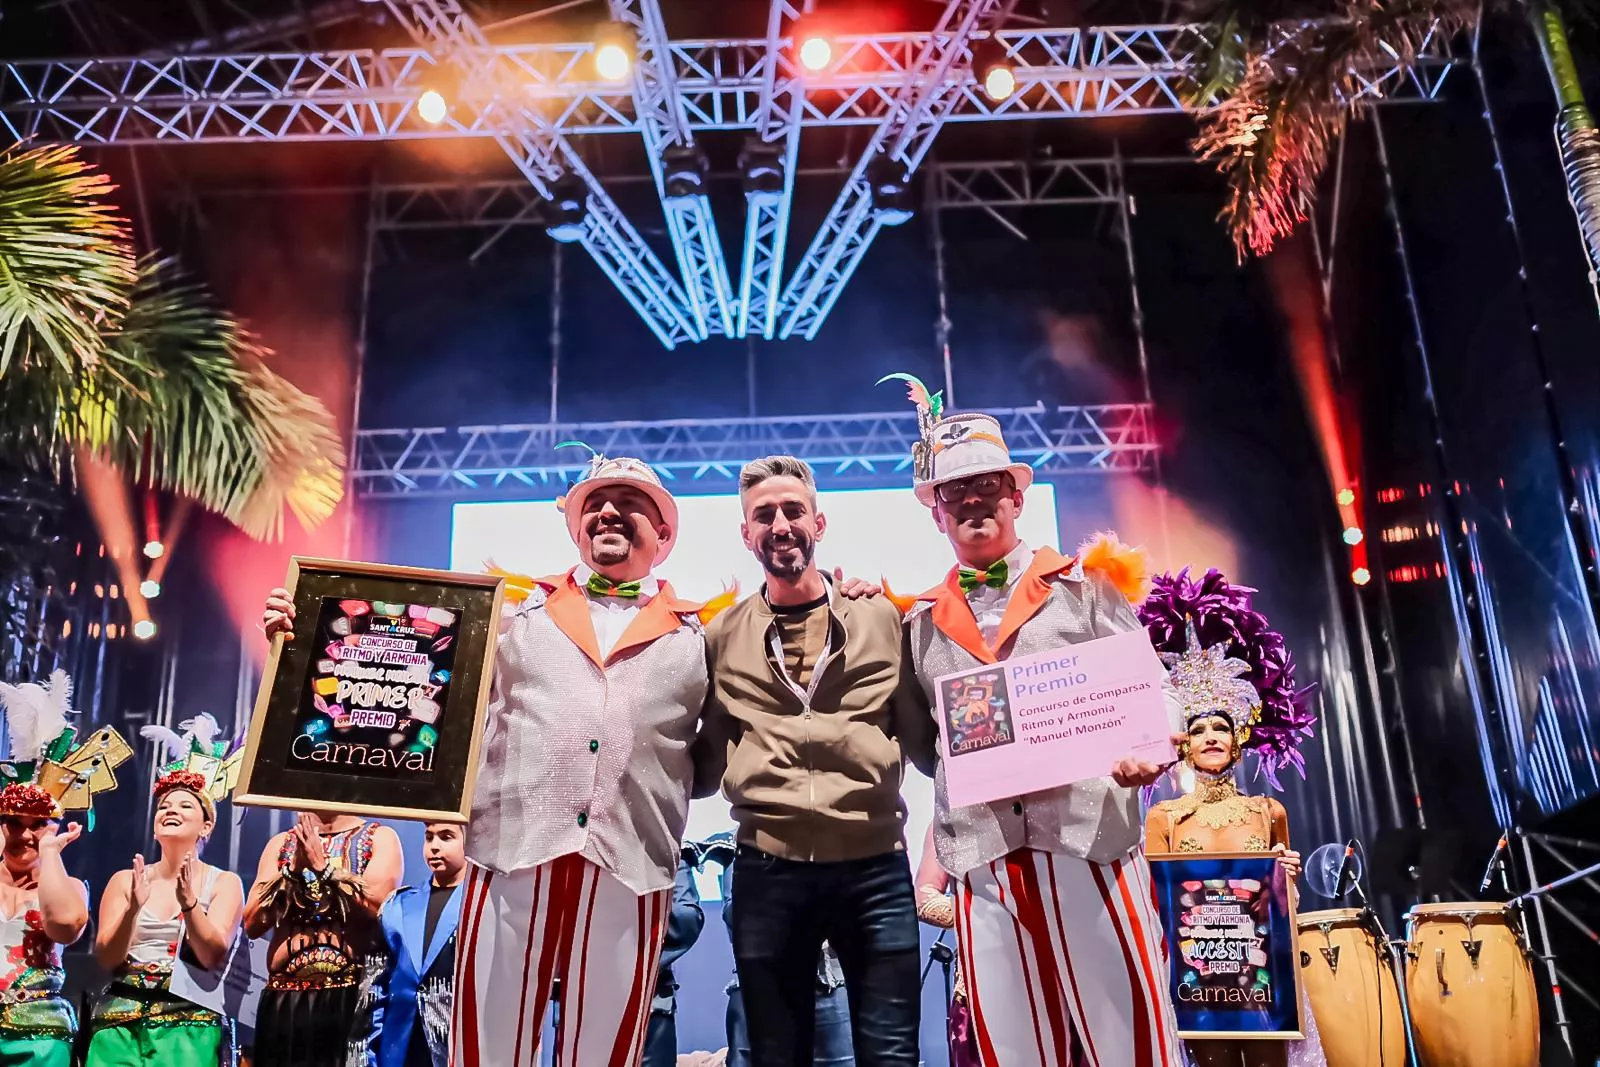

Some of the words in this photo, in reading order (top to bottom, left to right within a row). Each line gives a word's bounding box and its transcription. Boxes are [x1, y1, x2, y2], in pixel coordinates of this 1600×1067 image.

[342, 647, 373, 661] RITMO
[374, 651, 382, 661] Y
[360, 637, 403, 649] CONCURSO
[404, 641, 415, 651] DE
[1012, 655, 1079, 680] Primer
[336, 679, 424, 709] PRIMER
[1015, 672, 1087, 698] Premio
[1019, 699, 1070, 717] Concurso
[1072, 696, 1087, 705] de
[1089, 681, 1151, 701] Comparsas
[351, 711, 395, 727] PREMIO
[1021, 717, 1055, 731] Ritmo
[1057, 717, 1064, 725] y
[1067, 704, 1115, 721] Armonía
[951, 728, 1011, 752] Carnaval
[291, 733, 435, 772] Carnaval
[1192, 916, 1213, 925] RITMO
[1202, 906, 1231, 914] CONCURSO
[1232, 906, 1240, 914] DE
[1210, 962, 1239, 972] PREMIO
[1177, 982, 1272, 1003] Carnaval
